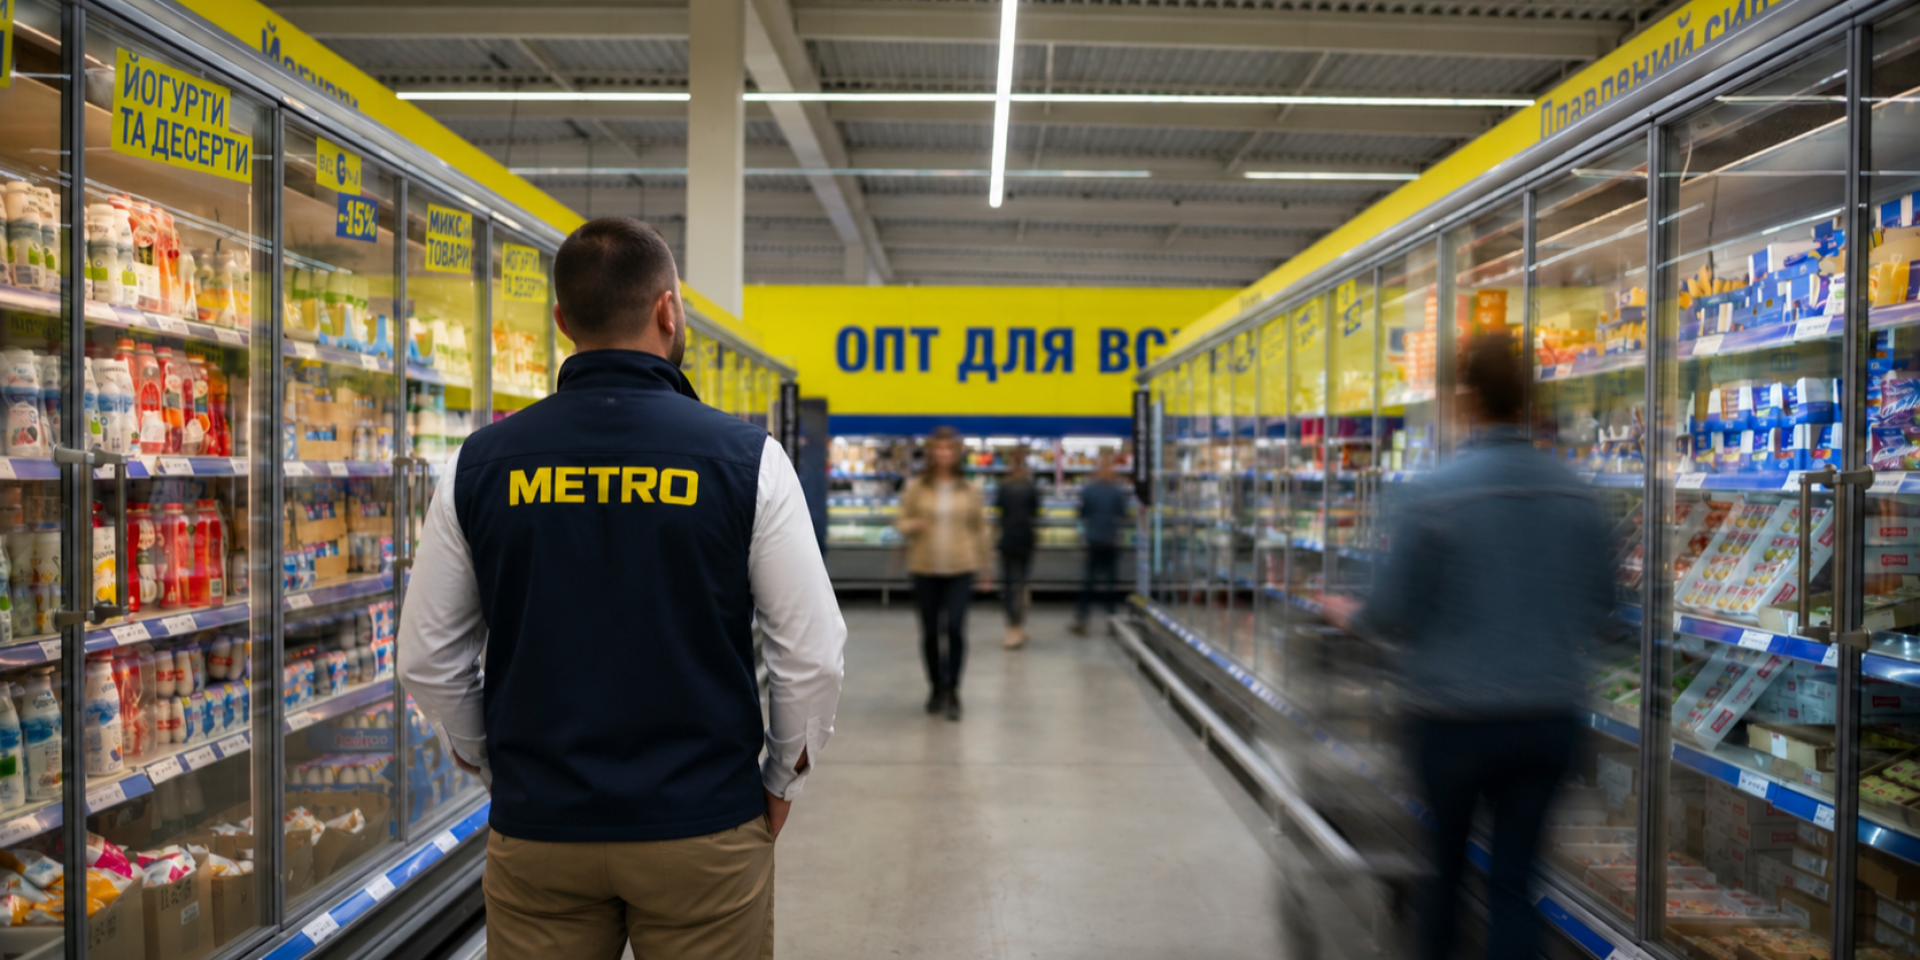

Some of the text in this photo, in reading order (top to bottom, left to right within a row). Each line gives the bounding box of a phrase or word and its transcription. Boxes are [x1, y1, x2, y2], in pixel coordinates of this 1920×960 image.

[123, 52, 225, 128] ЙОГУРТИ
[120, 106, 248, 175] ТА ДЕСЕРТИ
[836, 326, 940, 374] ОПТ
[957, 327, 1076, 383] ДЛЯ
[1099, 327, 1181, 374] ВС
[509, 466, 699, 507] METRO
